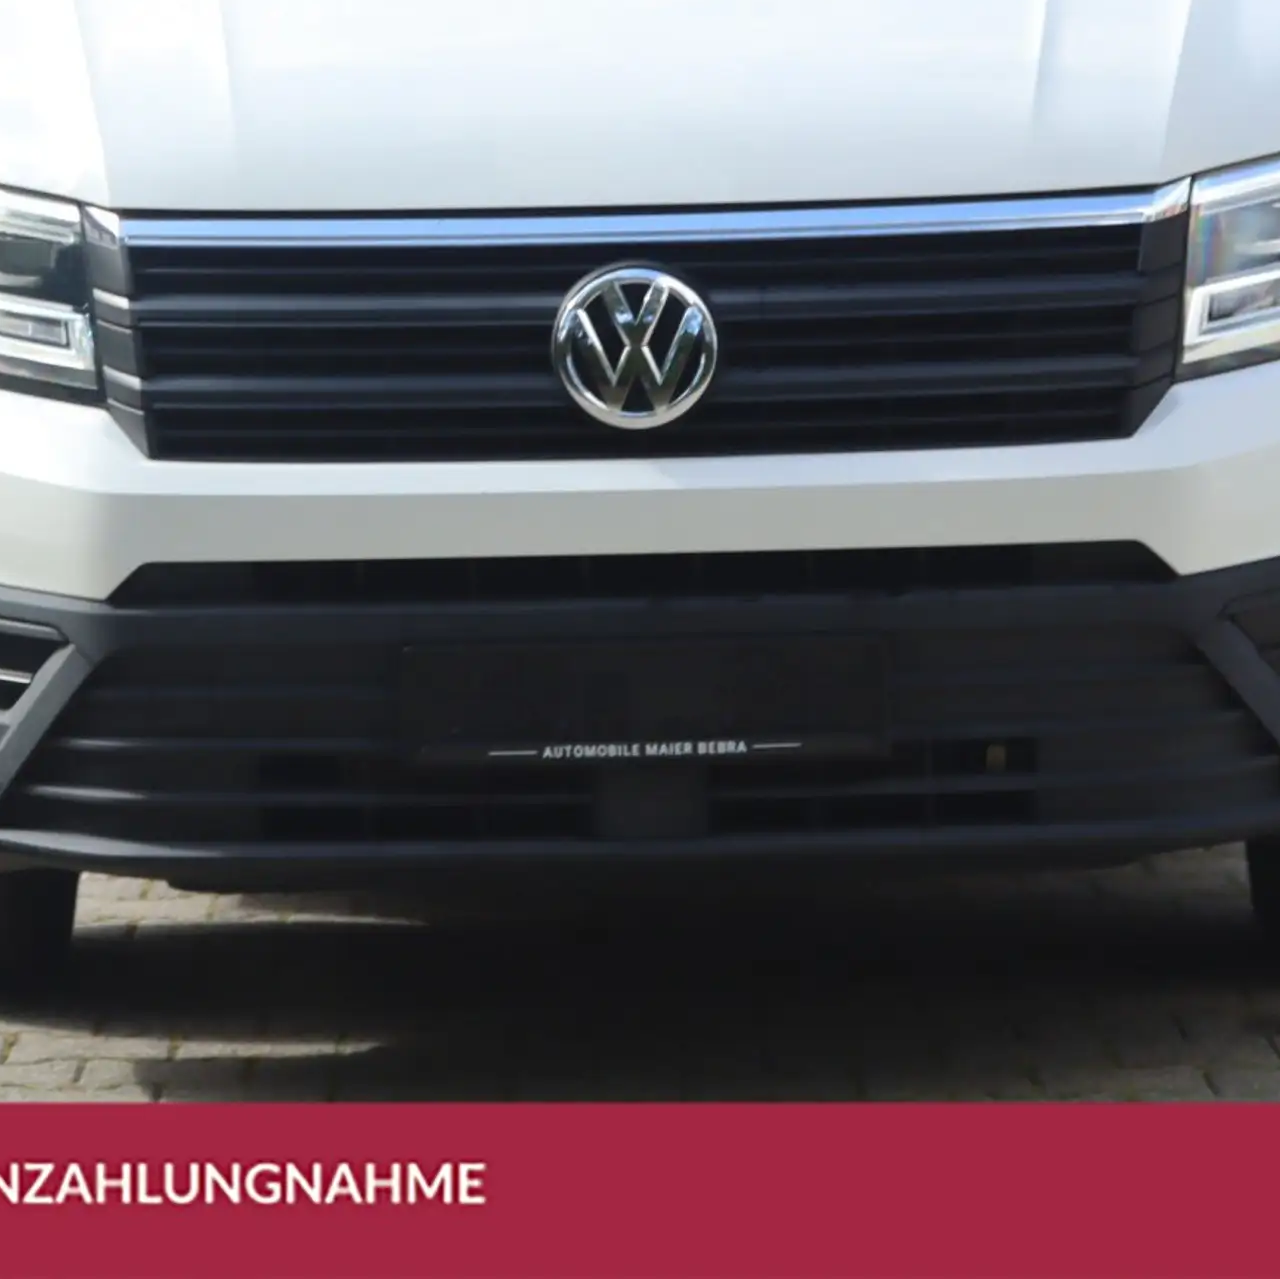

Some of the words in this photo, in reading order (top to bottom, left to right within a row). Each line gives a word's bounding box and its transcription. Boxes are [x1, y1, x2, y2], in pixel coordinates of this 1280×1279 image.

[558, 272, 712, 423] VW
[543, 744, 640, 759] AUTOMOBILE
[645, 742, 693, 756] MAIER
[697, 740, 748, 754] BEBRA
